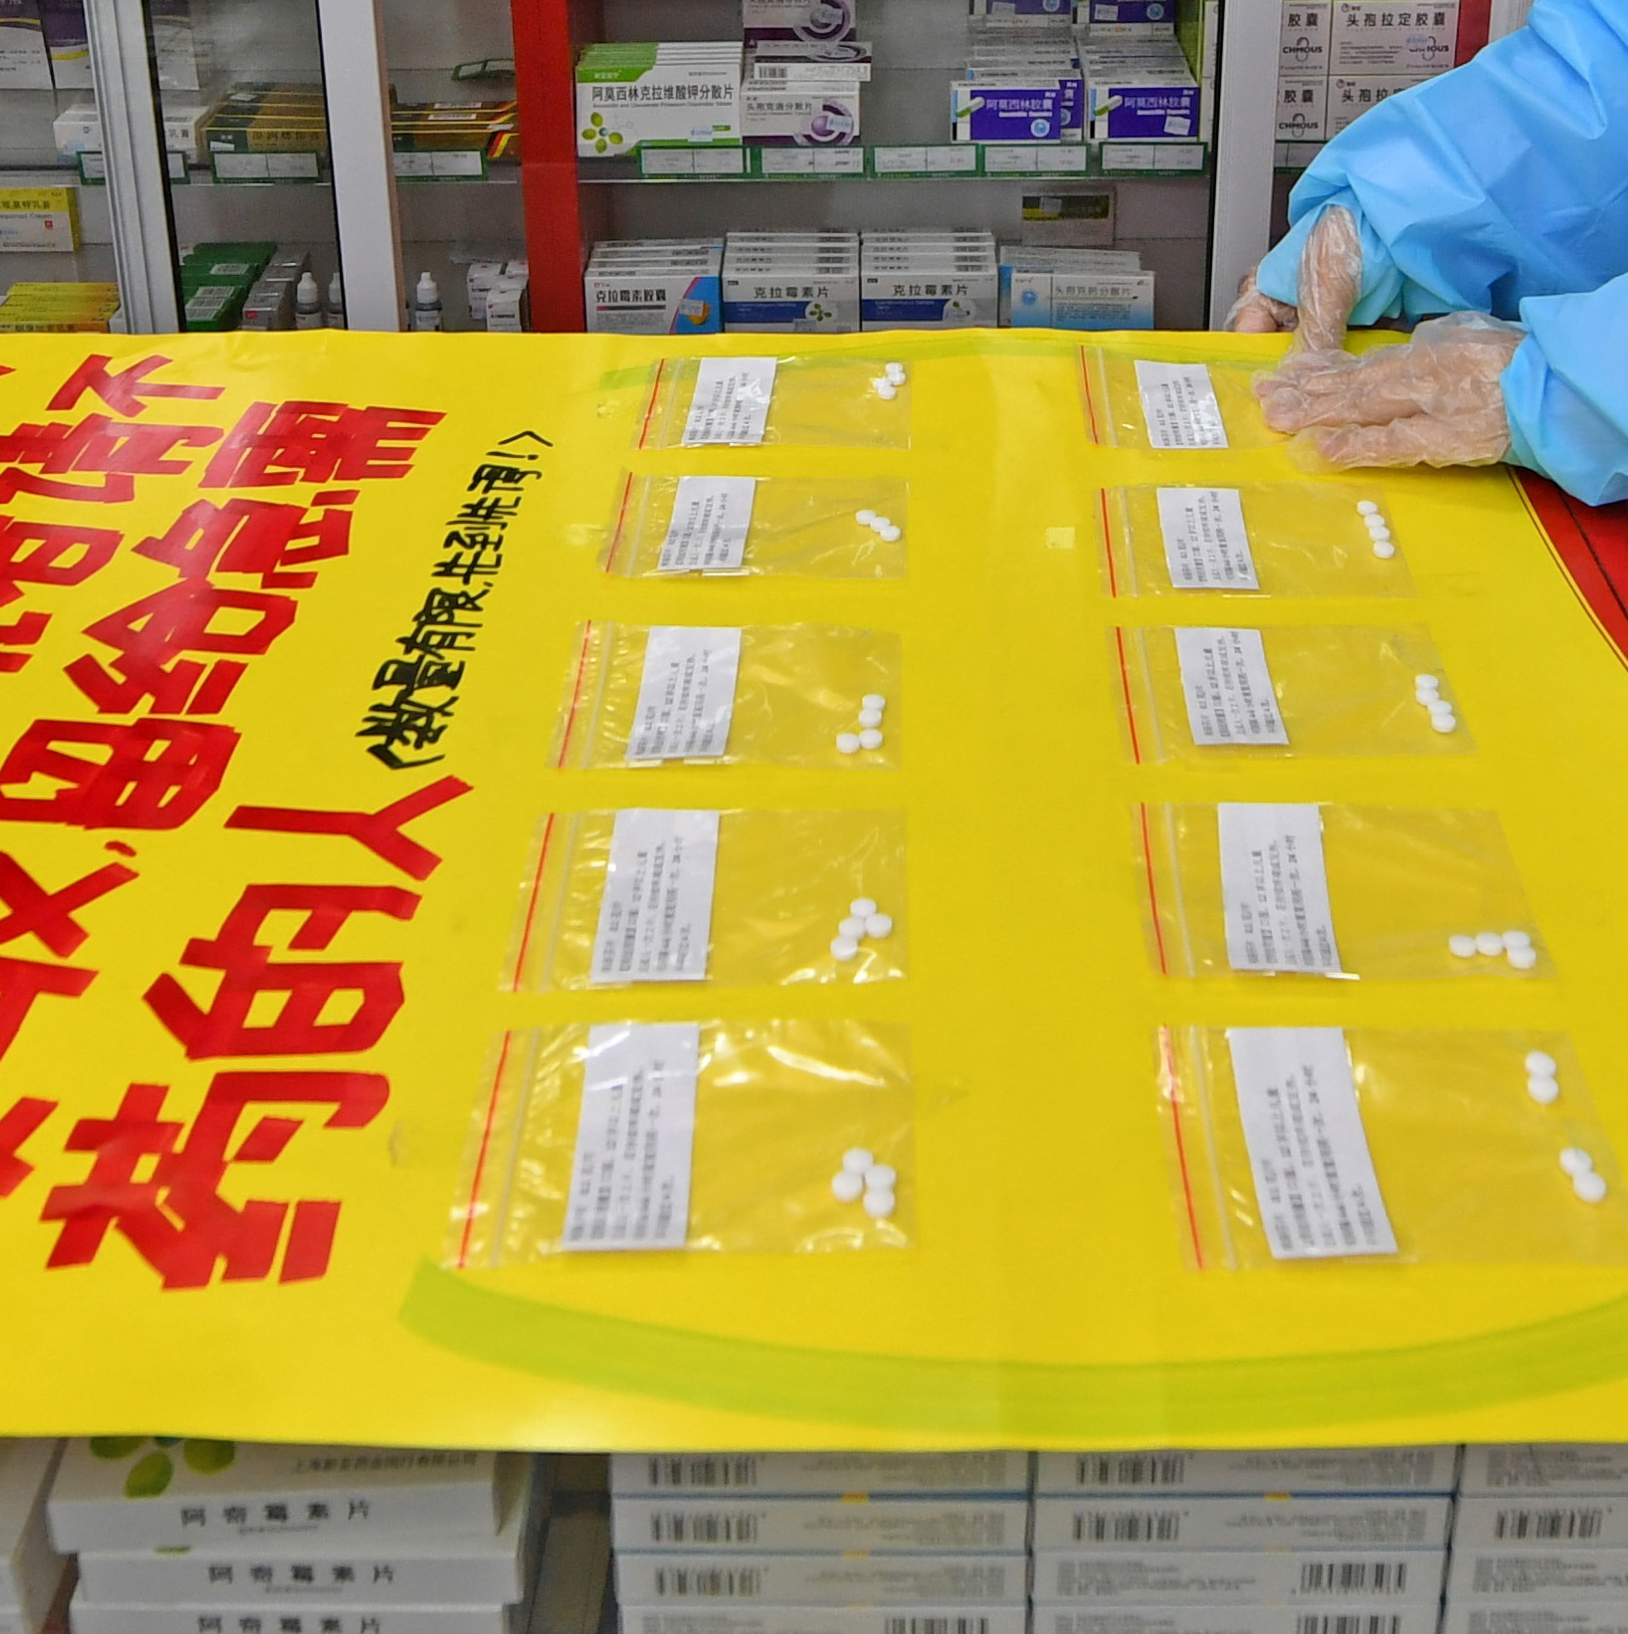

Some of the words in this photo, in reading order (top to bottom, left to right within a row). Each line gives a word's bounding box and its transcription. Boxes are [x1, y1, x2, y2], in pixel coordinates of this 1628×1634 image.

[1288, 12, 1320, 29] 胶囊
[1346, 11, 1447, 29] 头孢拉定胶囊
[591, 84, 734, 101] 阿莫西林克拉维酸钾分散片
[1283, 88, 1315, 104] 胶囊
[985, 97, 1054, 110] 阿莫西林胶囊
[1124, 96, 1192, 110] 阿莫西林胶囊
[596, 288, 667, 304] 克拉霉素胶囊
[754, 286, 830, 300] 克拉霉素片
[892, 284, 969, 297] 克拉霉素片
[41, 775, 480, 1289] 药的人
[180, 1500, 372, 1529] 阿奇霉素片
[208, 1564, 396, 1586] 阿奇霉素片
